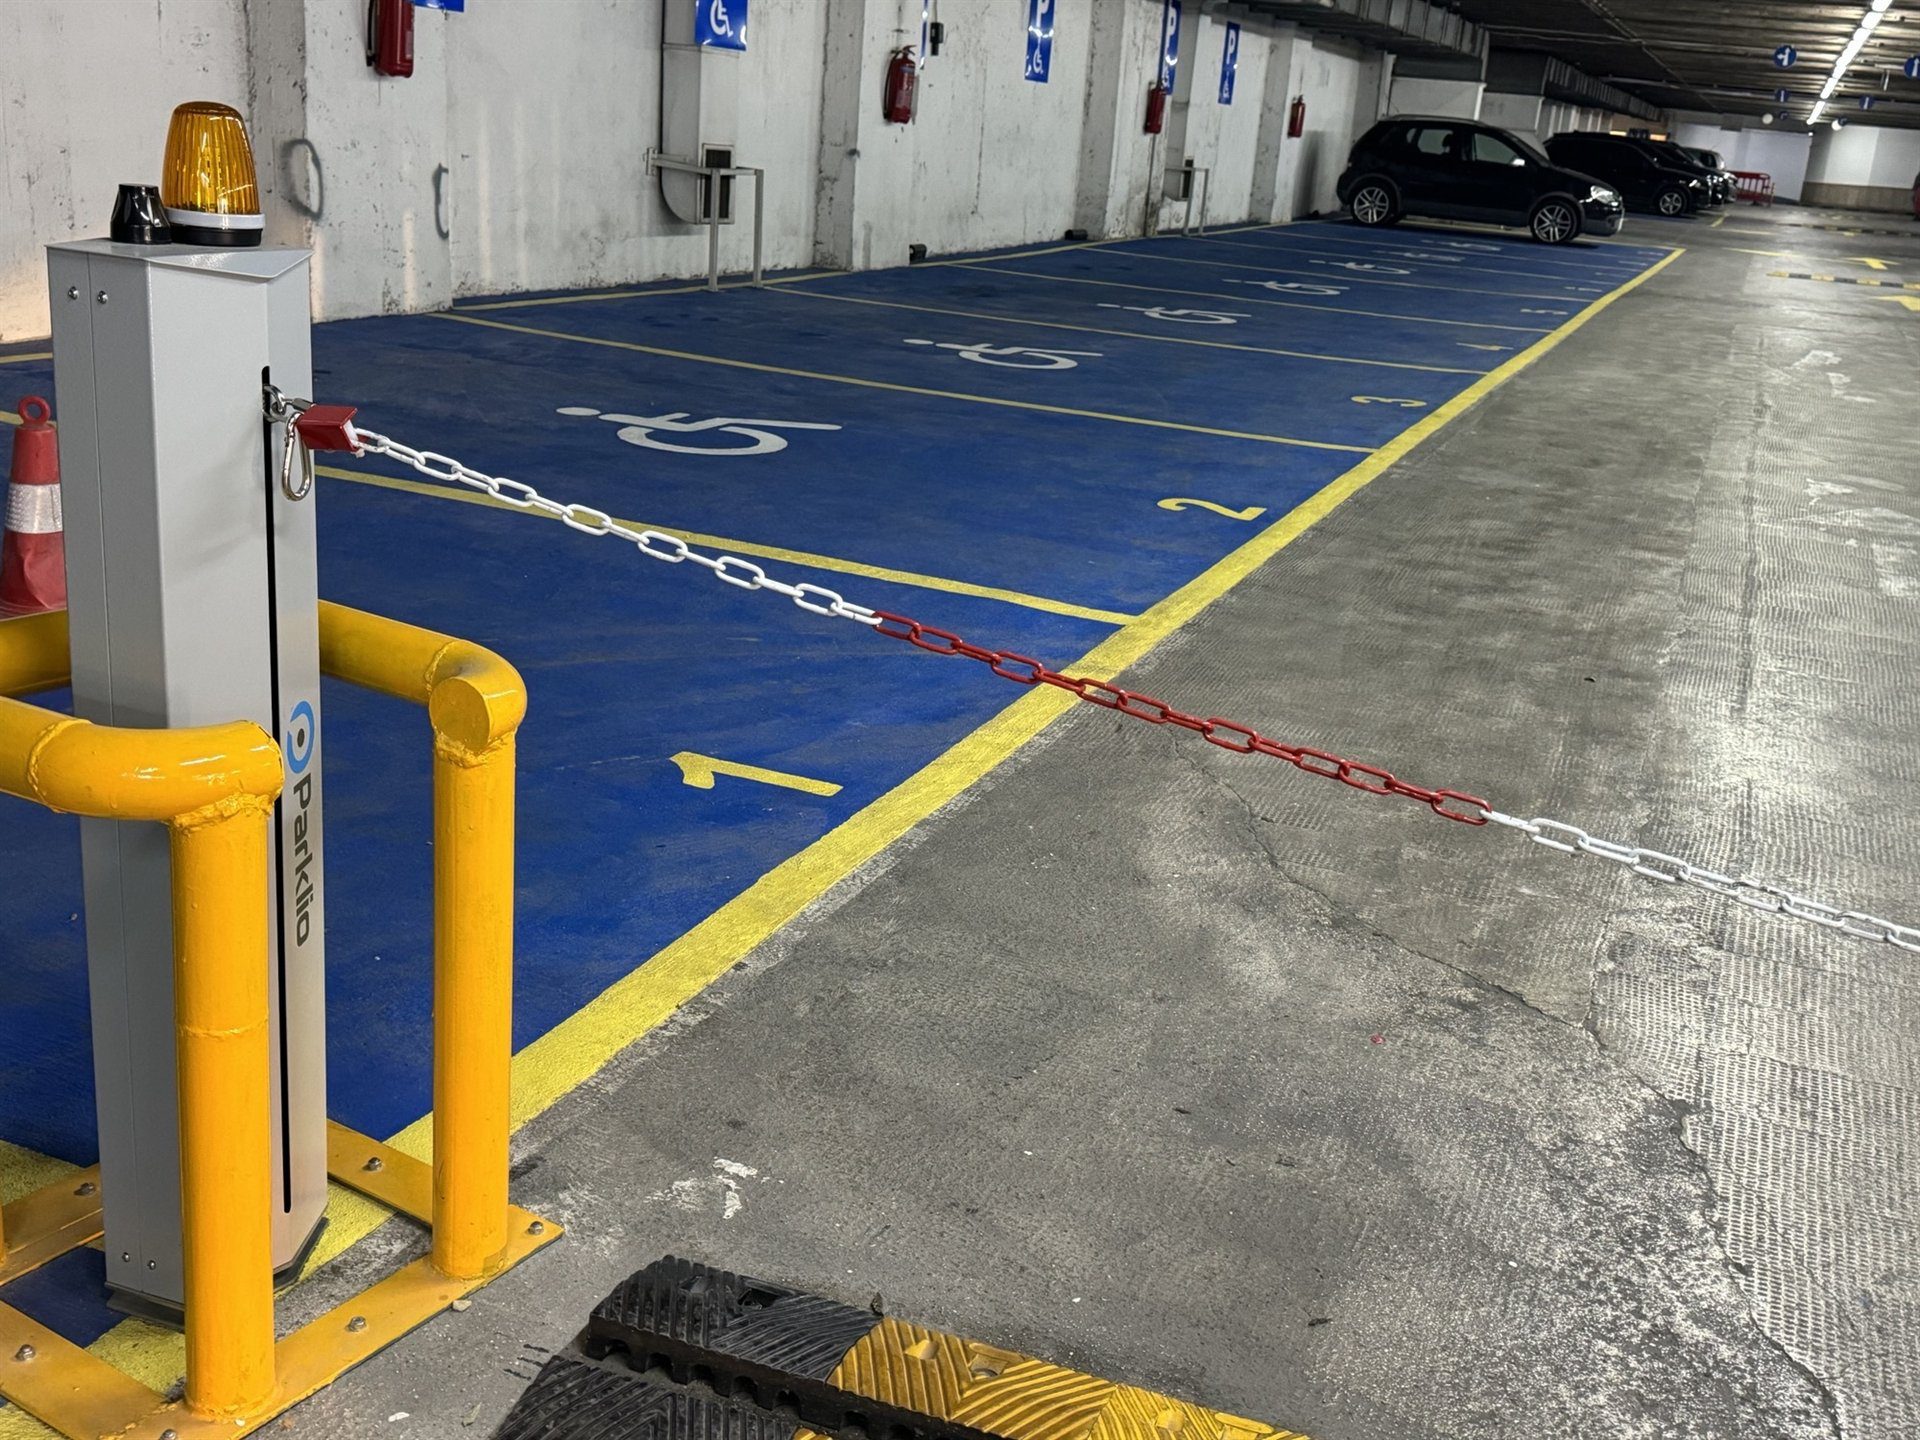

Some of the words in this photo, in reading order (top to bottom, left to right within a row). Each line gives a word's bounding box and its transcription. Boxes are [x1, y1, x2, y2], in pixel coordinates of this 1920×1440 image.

[1164, 5, 1177, 57] P
[1226, 29, 1236, 64] P
[1351, 395, 1427, 408] 3
[1157, 497, 1267, 521] 2
[669, 751, 844, 797] 1
[293, 772, 314, 947] Parklio
